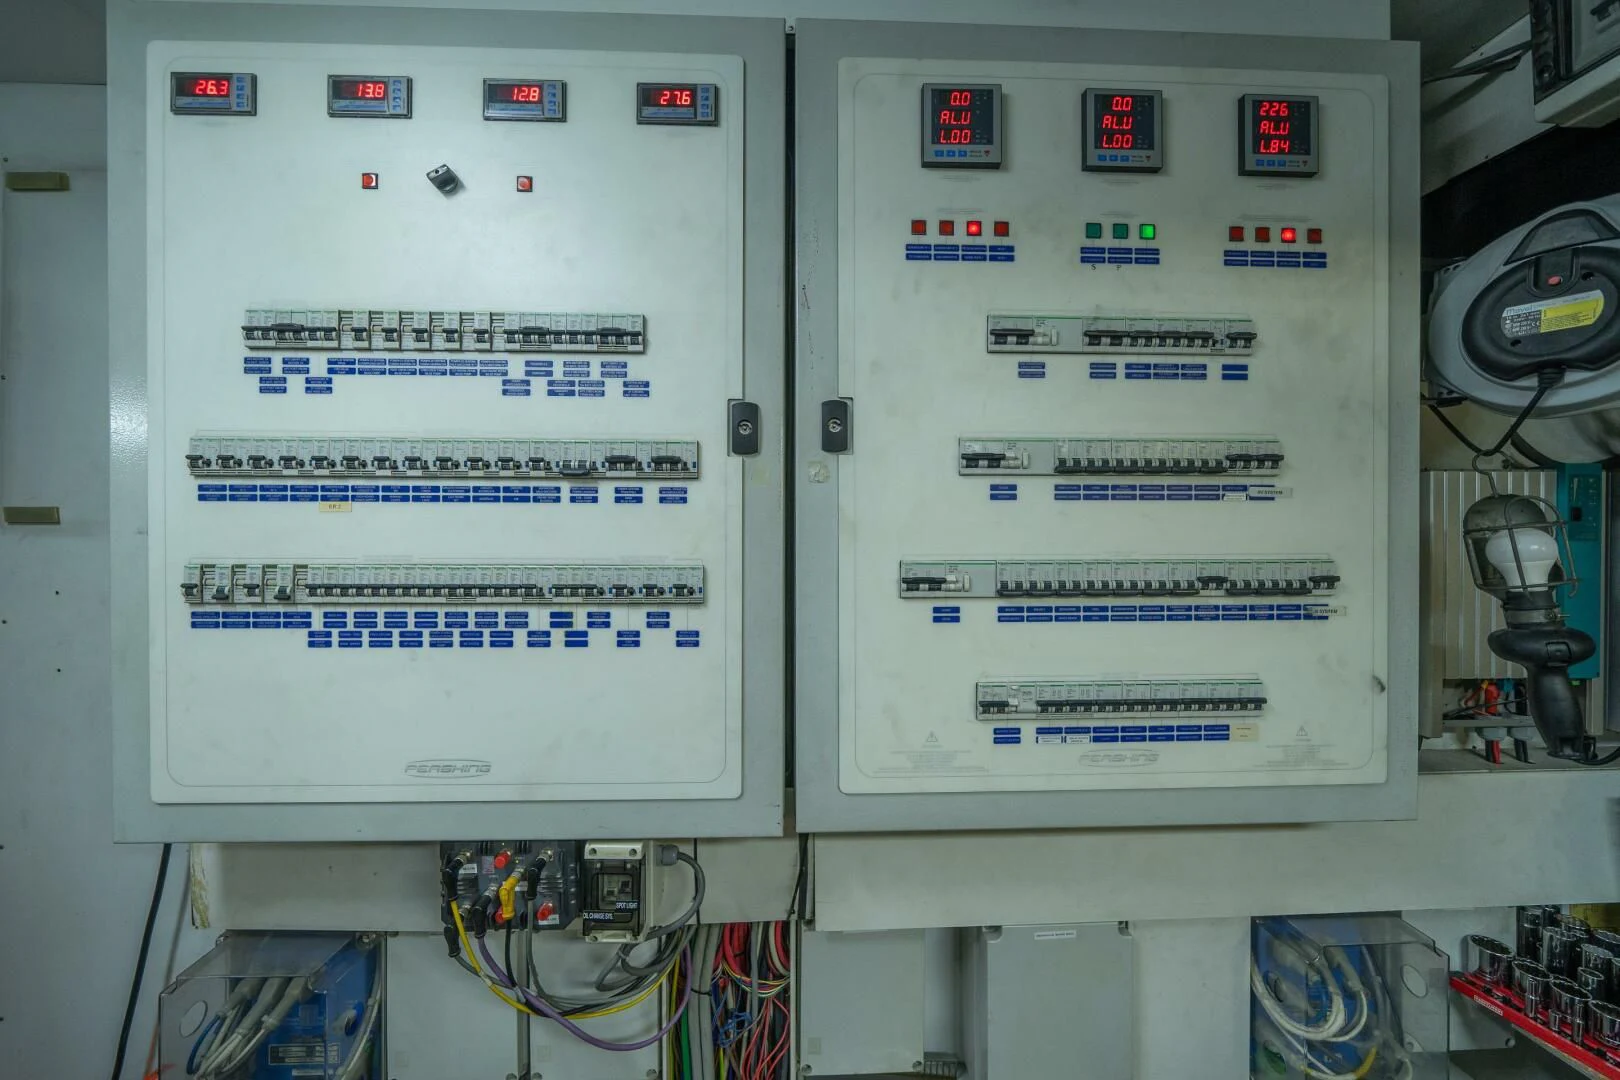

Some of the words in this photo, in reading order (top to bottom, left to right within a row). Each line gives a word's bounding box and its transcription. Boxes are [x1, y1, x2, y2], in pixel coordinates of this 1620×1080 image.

[195, 80, 228, 95] 26.3
[358, 83, 385, 98] 13.8
[513, 87, 540, 101] 12.8
[660, 91, 691, 105] 27.6
[1259, 102, 1288, 116] 226
[589, 912, 604, 920] CHANGE
